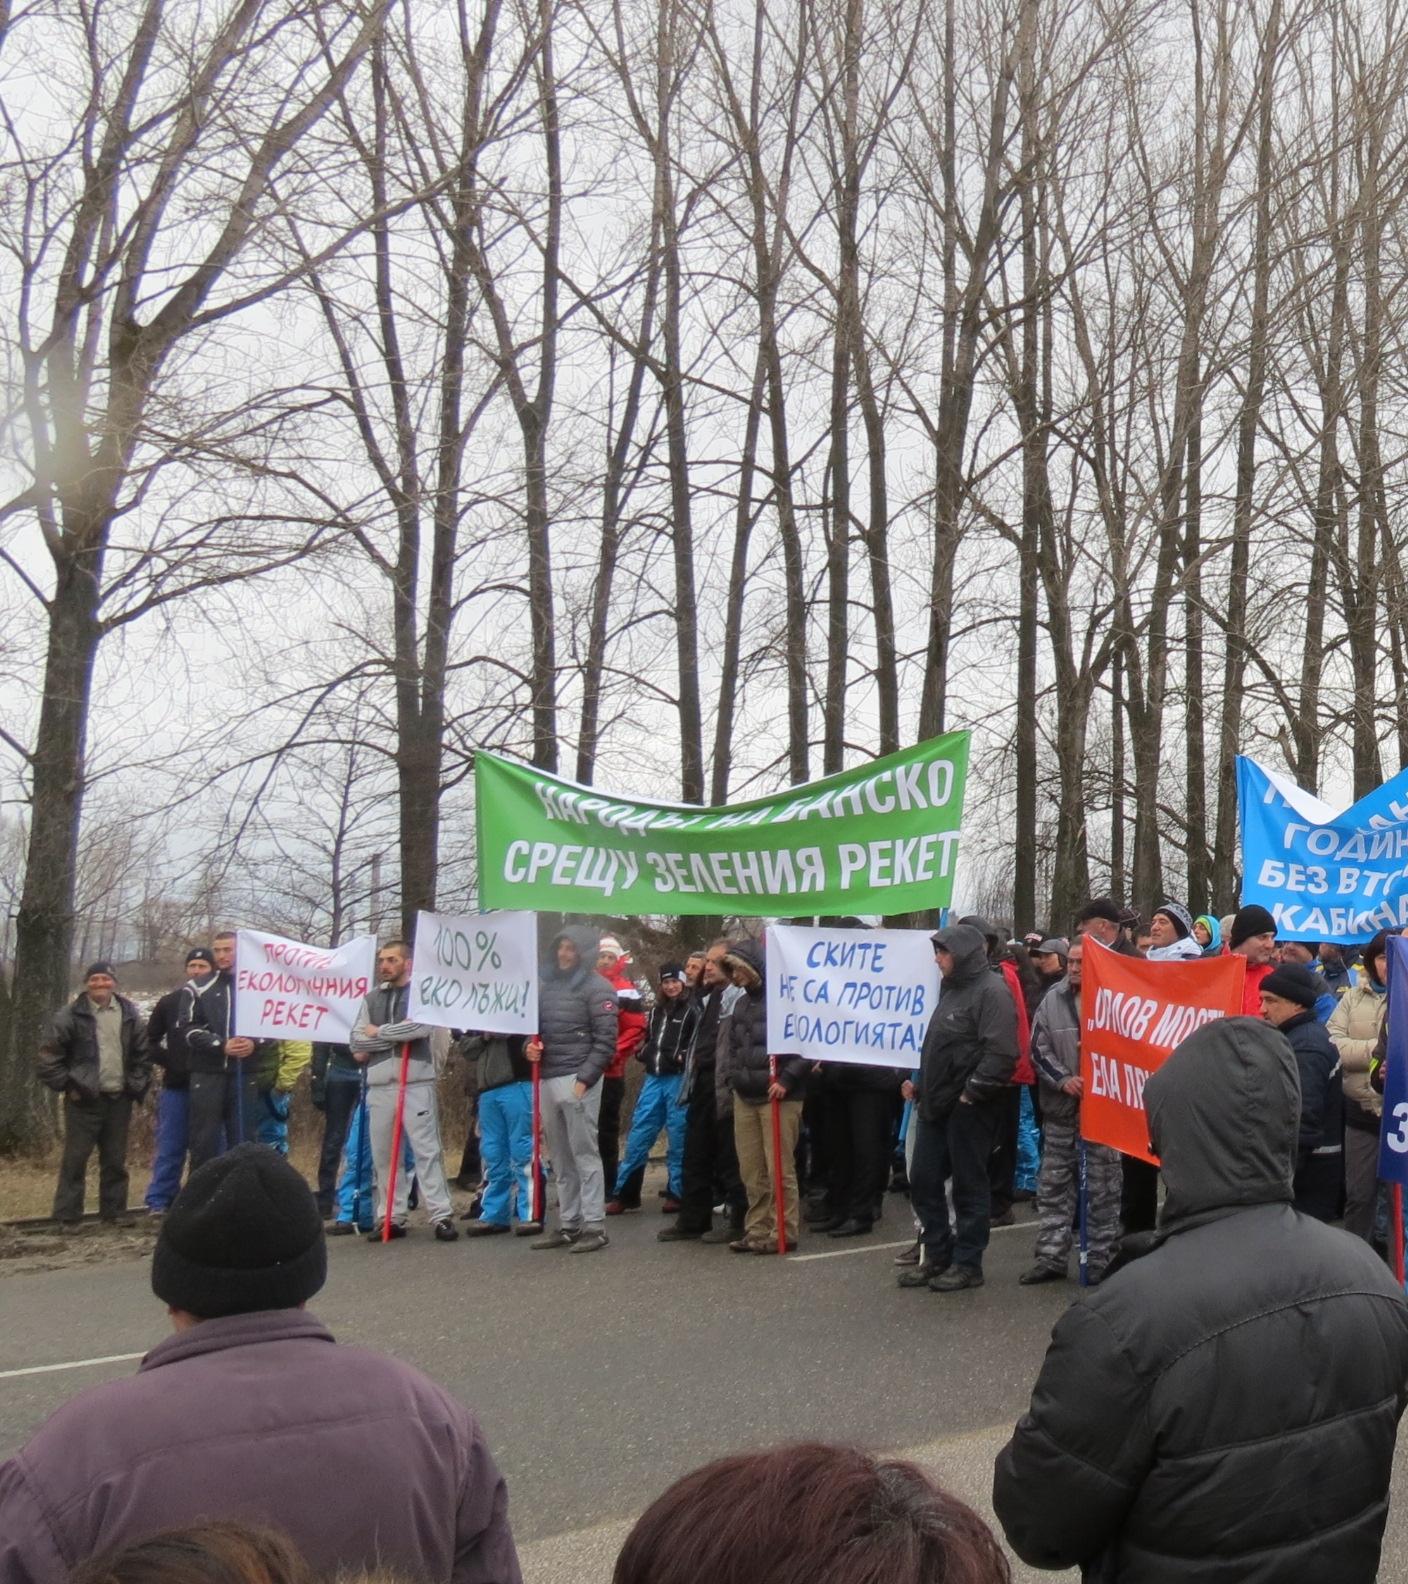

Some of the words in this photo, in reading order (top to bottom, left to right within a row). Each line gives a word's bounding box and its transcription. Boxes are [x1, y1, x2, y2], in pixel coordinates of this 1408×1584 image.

[704, 806, 773, 829] НА
[771, 759, 954, 823] БАНСКО
[504, 839, 640, 897] СРЕЩУ
[652, 845, 826, 896] ЗЕЛЕНИЯ
[839, 829, 961, 890] РЕКЕТ
[1257, 858, 1329, 895] БЕЗ
[433, 923, 502, 972] 100%
[806, 940, 887, 973] СКИТЕ
[260, 998, 329, 1031] РЕКЕТ
[803, 978, 829, 1004] СА
[836, 981, 926, 1017] ПРОТИВ
[1089, 1051, 1123, 1104] ЕЛА
[1123, 1063, 1155, 1111] ПР
